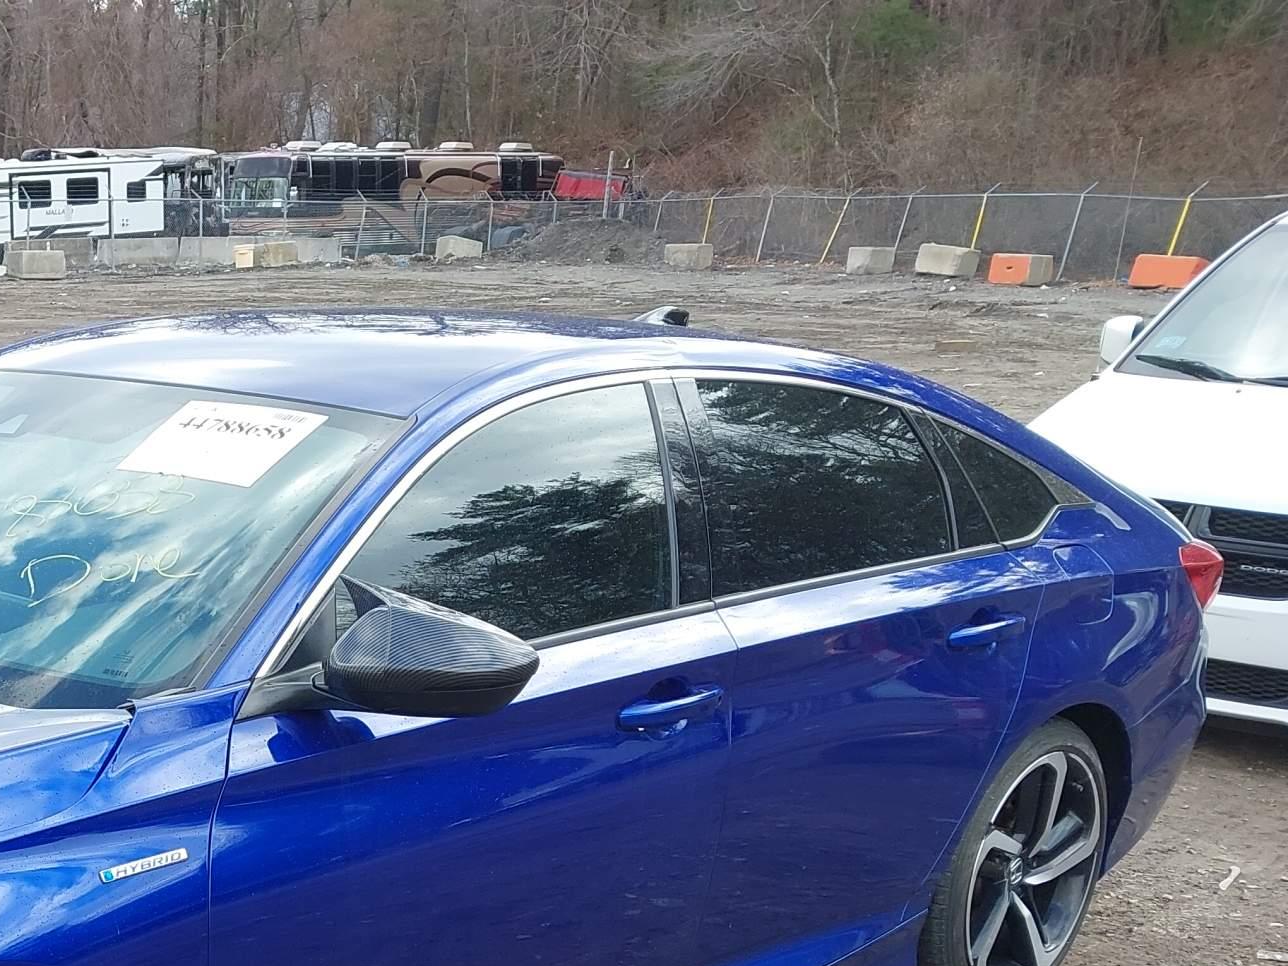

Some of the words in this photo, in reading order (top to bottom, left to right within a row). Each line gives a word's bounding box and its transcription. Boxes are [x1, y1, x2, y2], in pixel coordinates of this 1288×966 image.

[45, 208, 74, 216] MALLAD
[179, 416, 292, 440] 44788658
[19, 547, 200, 608] Done
[115, 851, 182, 877] HYBRID
